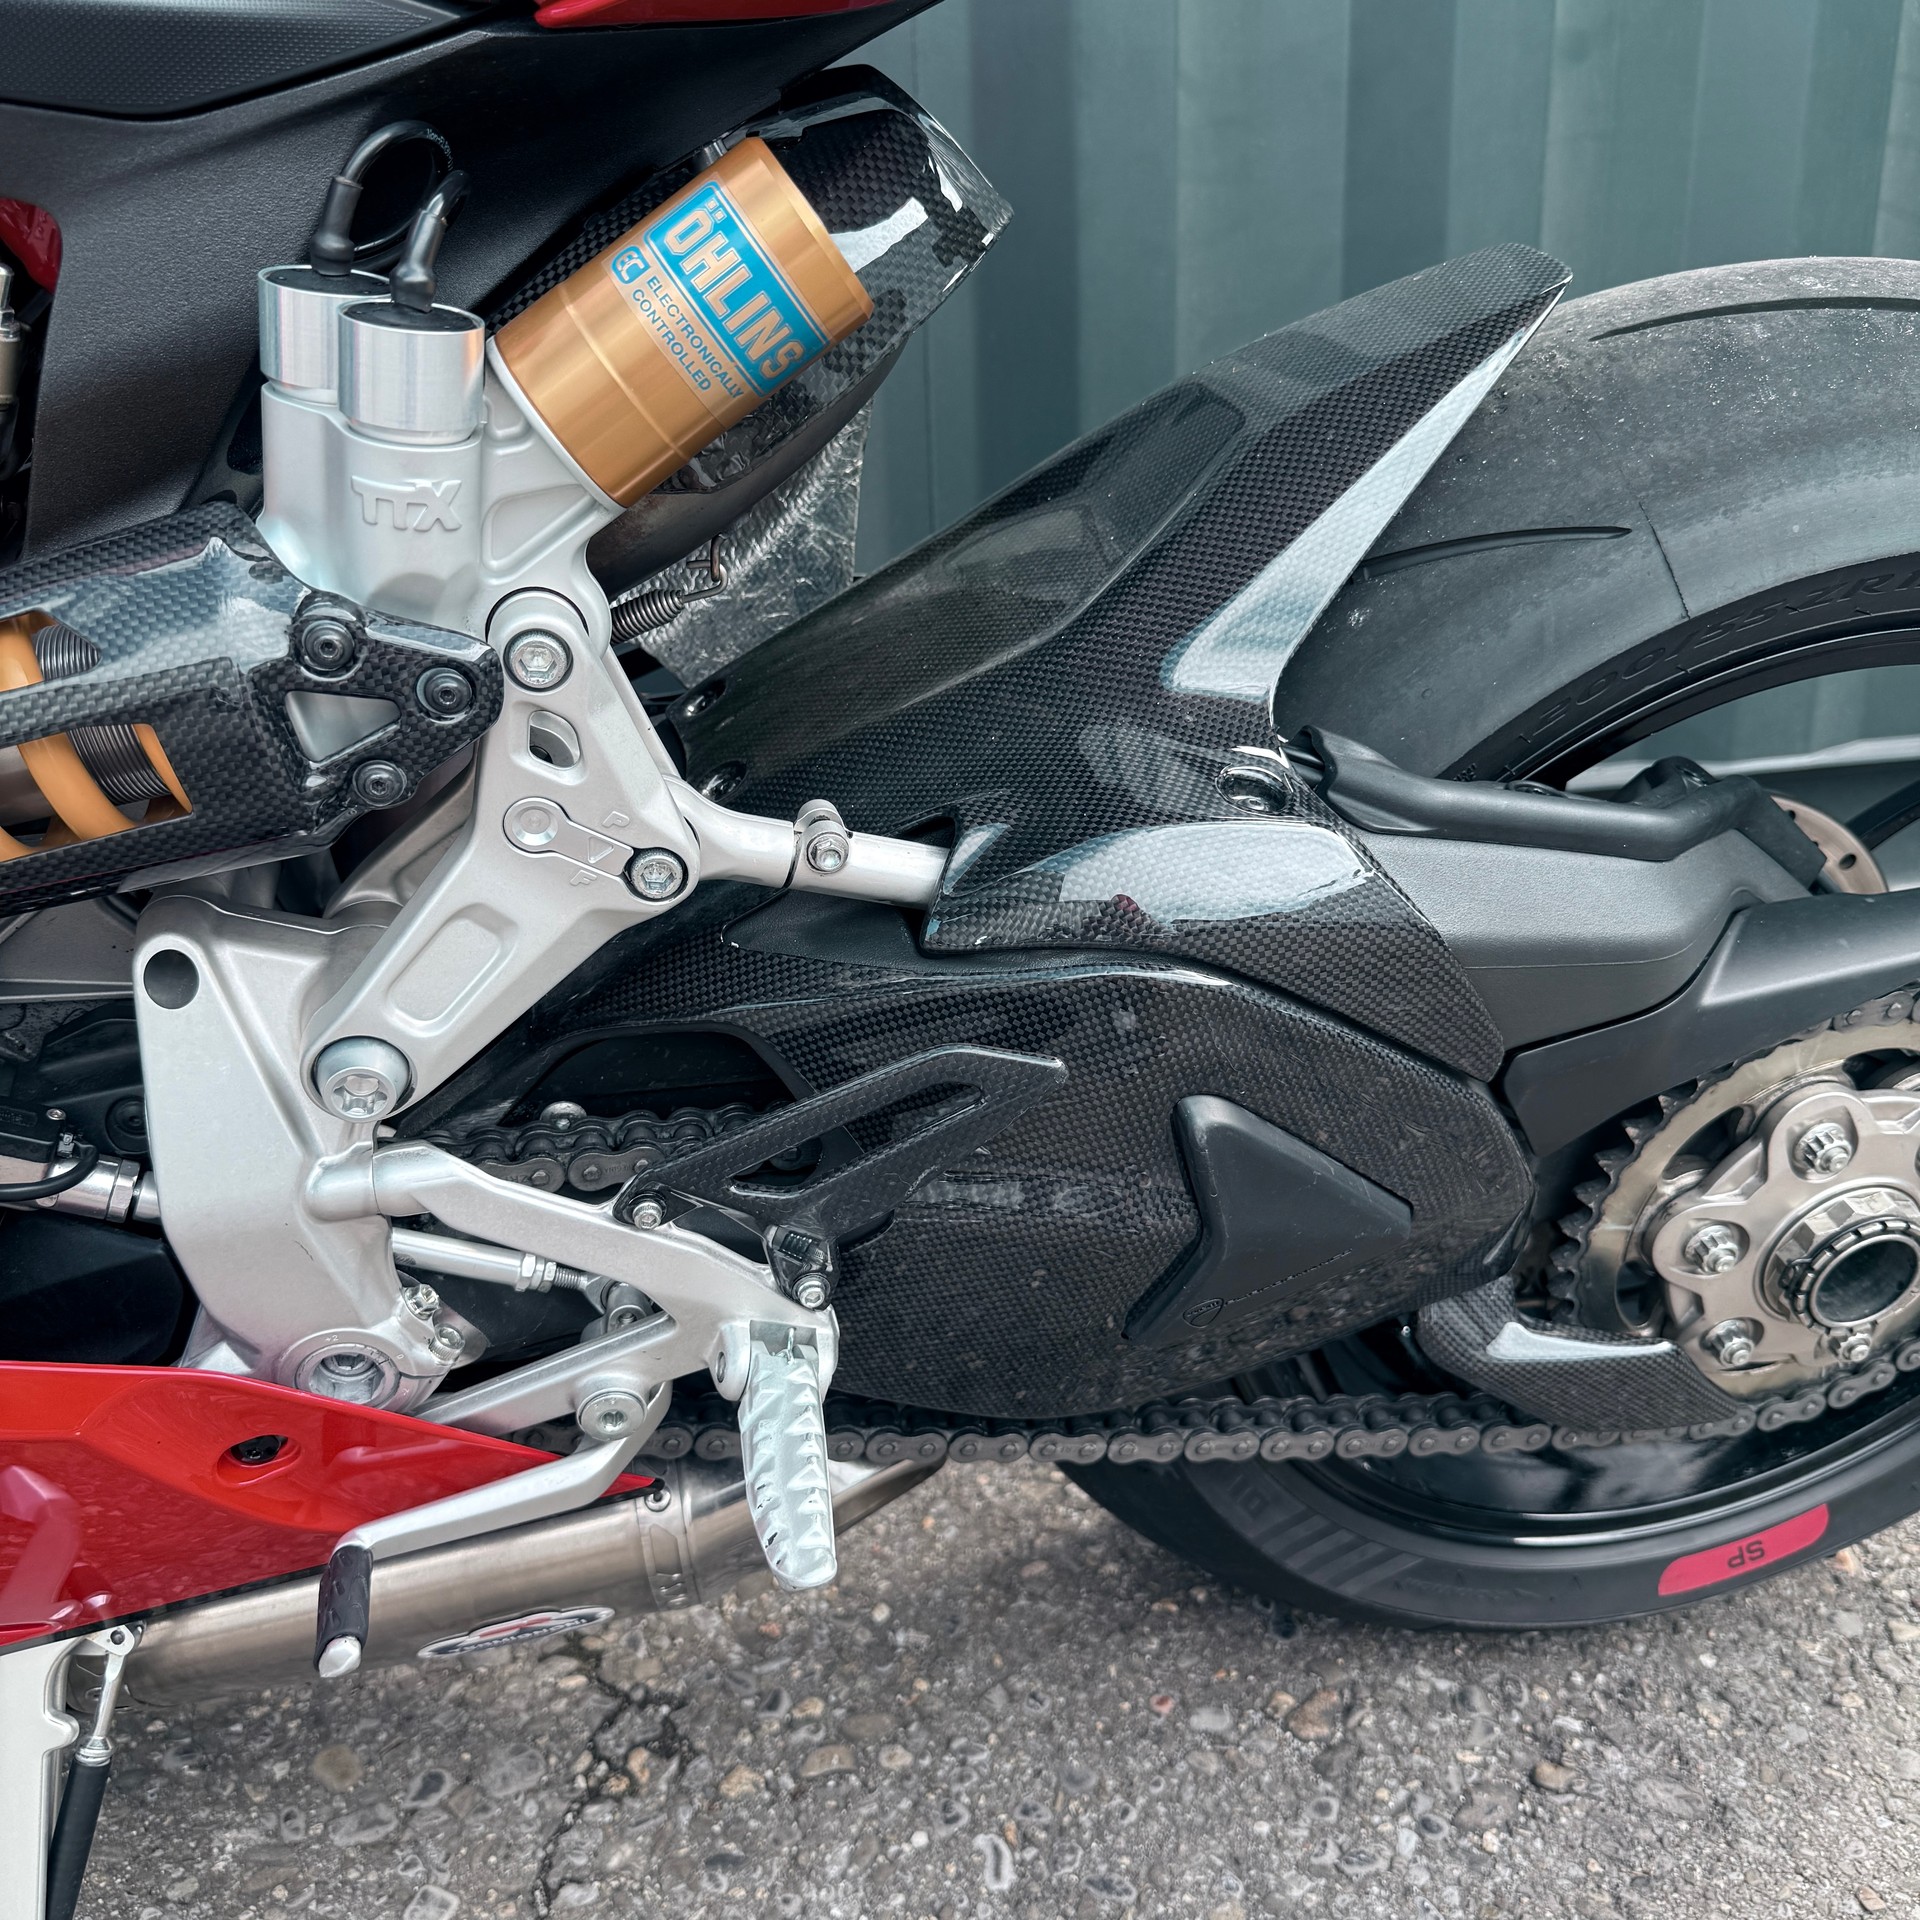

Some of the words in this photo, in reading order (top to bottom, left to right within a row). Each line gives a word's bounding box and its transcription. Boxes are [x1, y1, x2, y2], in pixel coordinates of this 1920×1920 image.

[632, 288, 712, 393] CONTROLLED
[646, 276, 745, 399] ELECTRONICALLY
[663, 198, 806, 380] ÖHLINS
[351, 475, 463, 533] TTX
[1532, 568, 1920, 738] 200/55ZR1
[1727, 1539, 1765, 1570] SP
